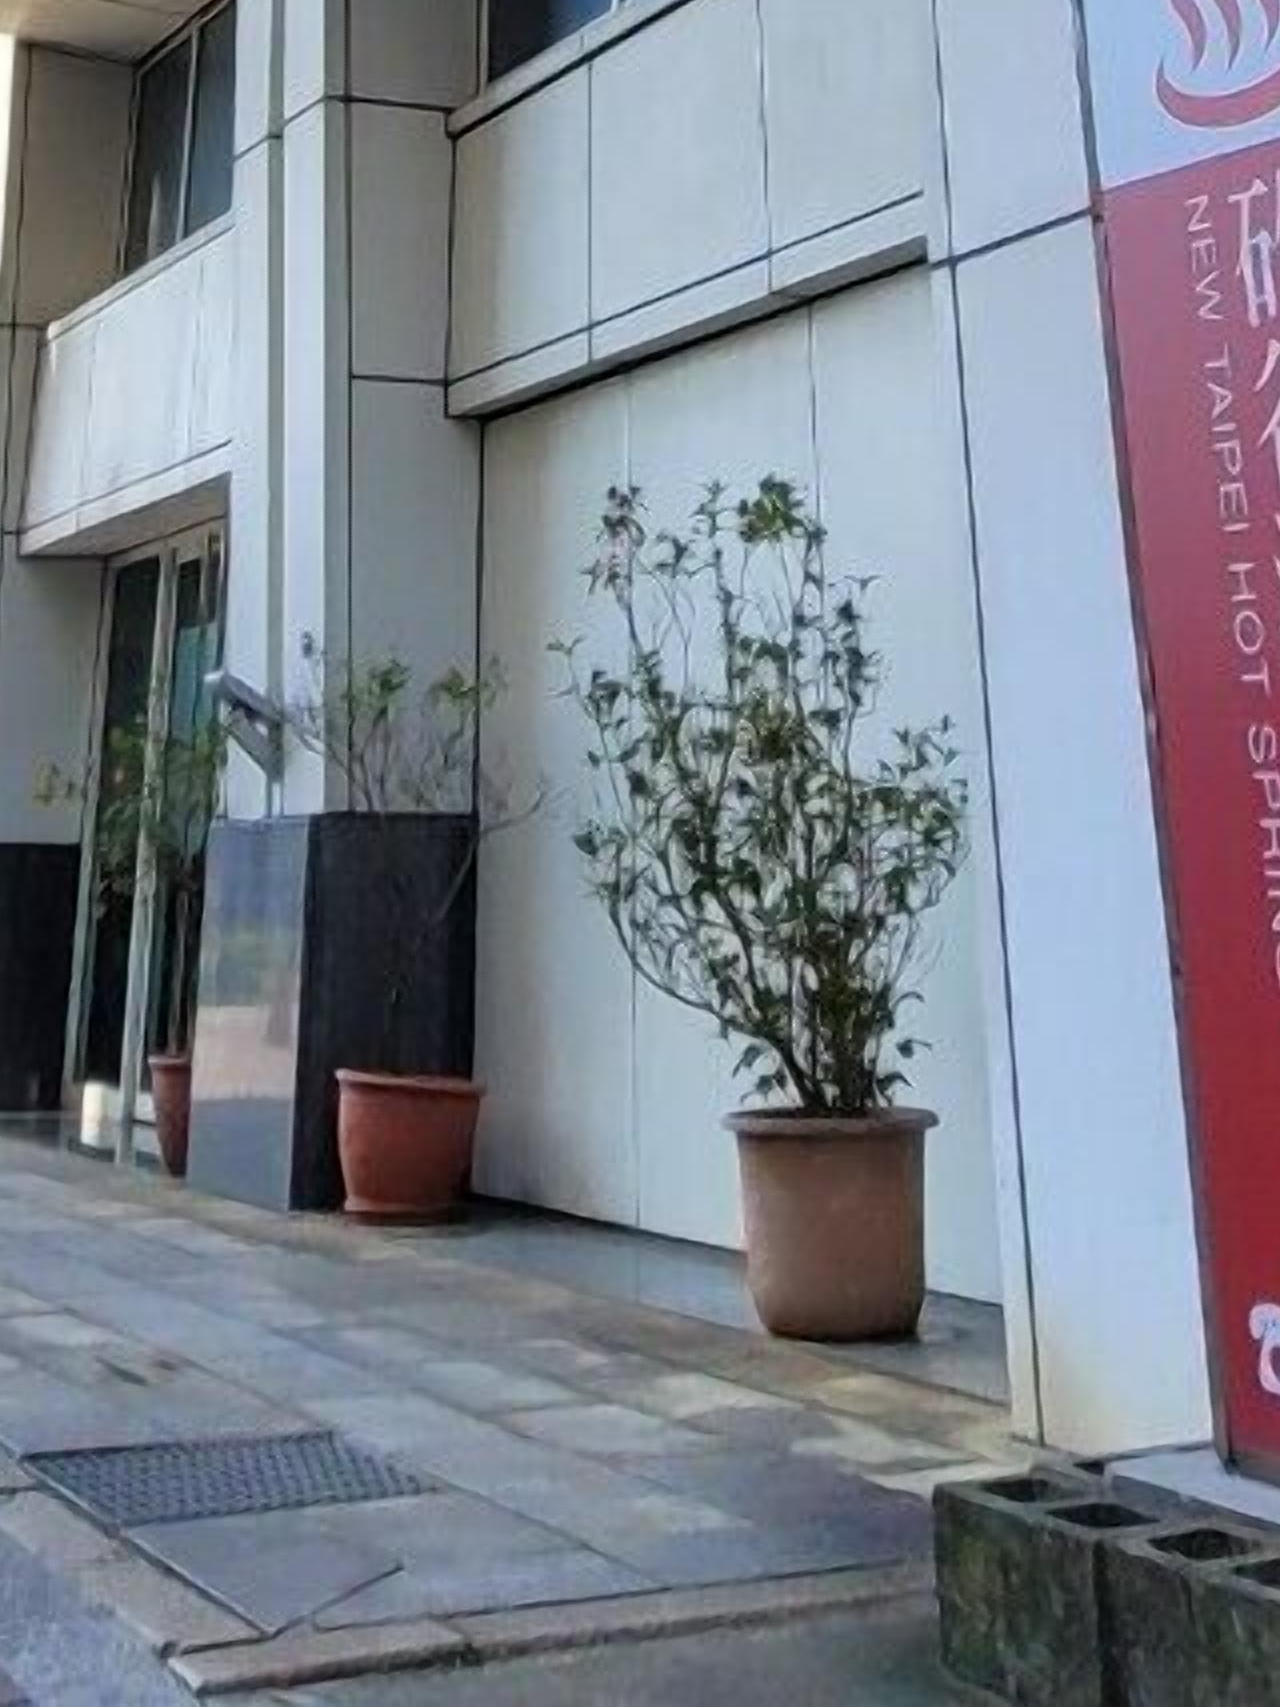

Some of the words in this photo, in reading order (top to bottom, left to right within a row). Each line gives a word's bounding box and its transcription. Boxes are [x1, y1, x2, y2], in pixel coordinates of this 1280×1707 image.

[1181, 193, 1225, 321] NEW
[1203, 342, 1251, 533] TAIPEI
[1225, 559, 1272, 697] HOT
